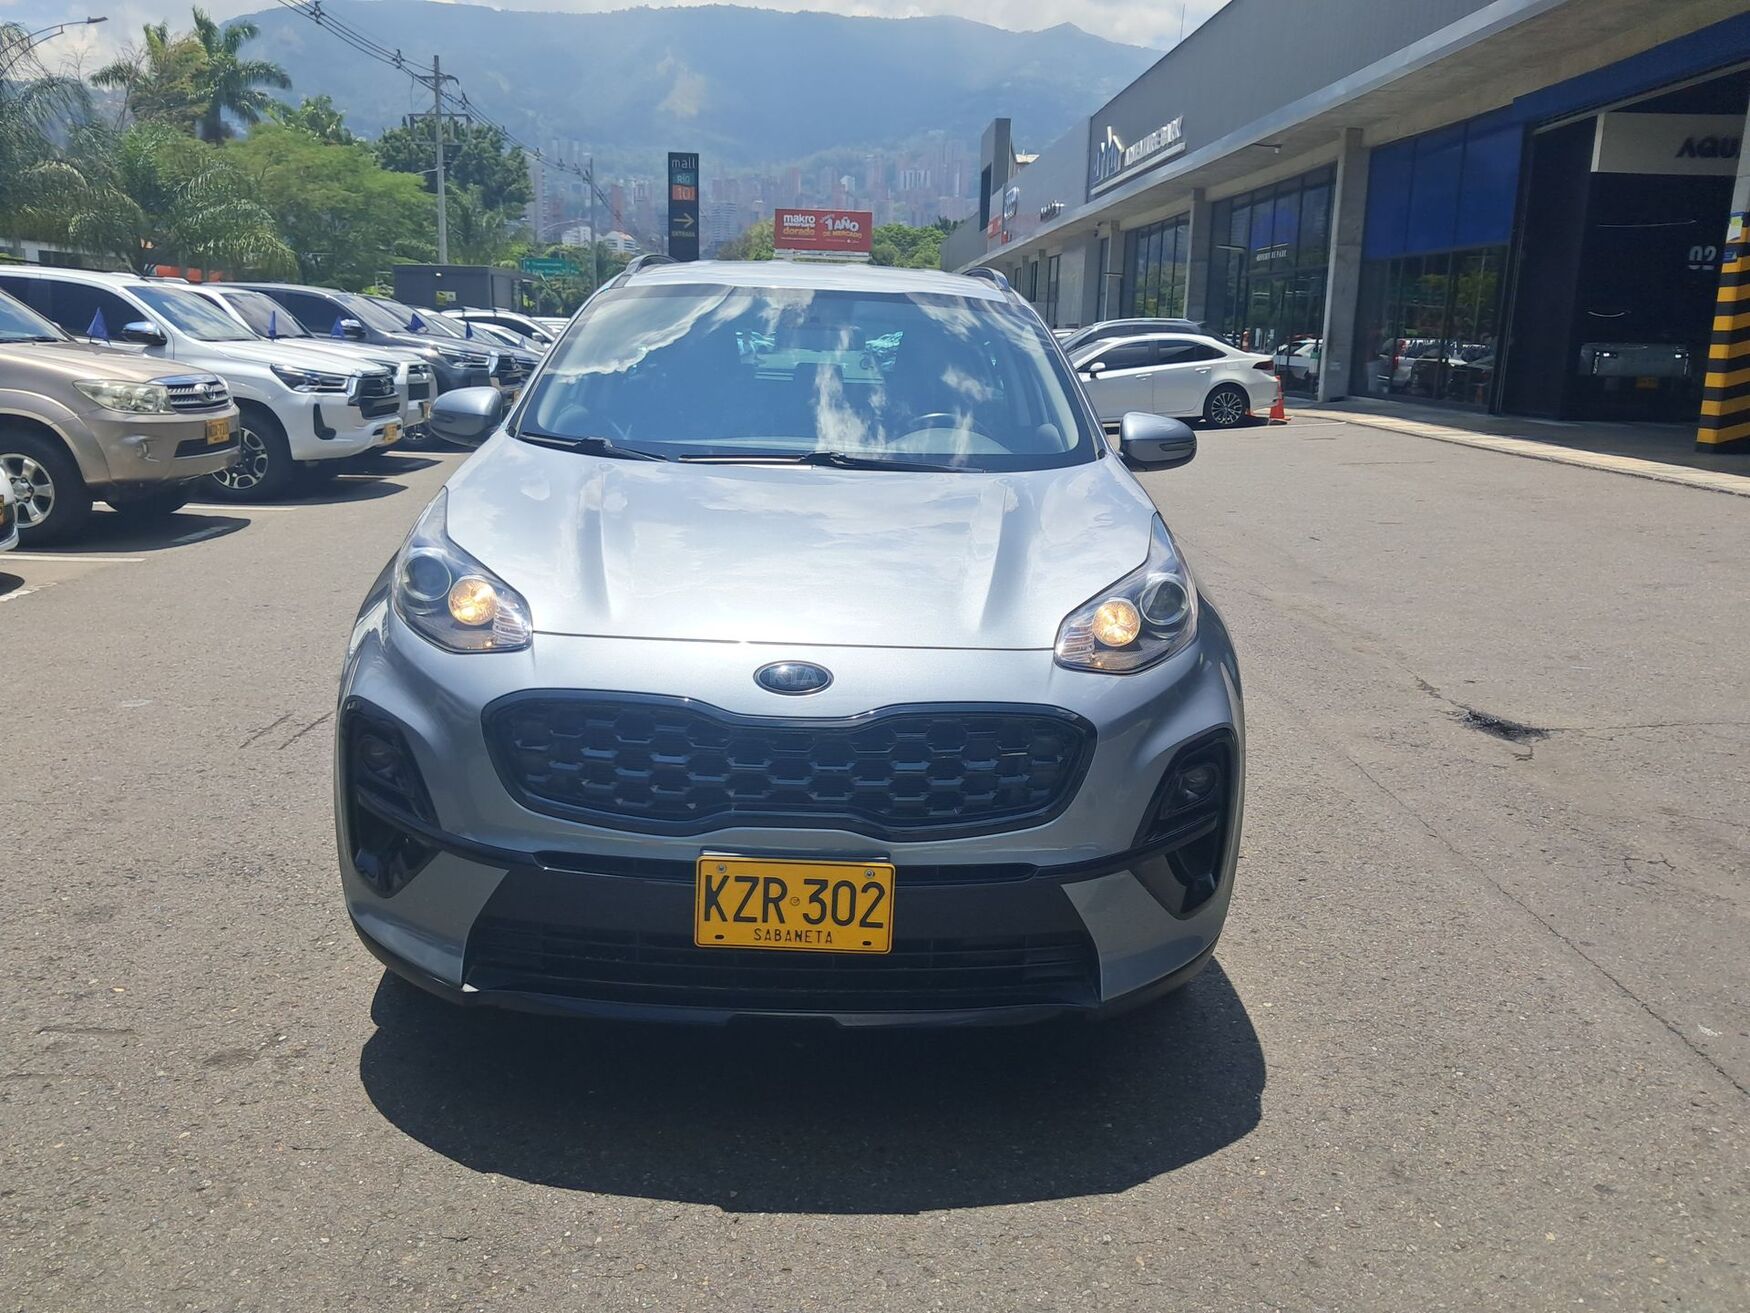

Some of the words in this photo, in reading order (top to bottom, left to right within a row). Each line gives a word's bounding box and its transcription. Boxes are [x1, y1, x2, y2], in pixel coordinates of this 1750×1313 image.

[672, 157, 696, 168] mall
[784, 214, 815, 223] makro
[825, 219, 834, 230] 1
[834, 217, 859, 231] AÑO
[783, 227, 815, 235] dorado
[1688, 245, 1717, 271] 02
[767, 667, 820, 686] KIA
[704, 874, 788, 924] KZR
[802, 878, 886, 929] 302
[754, 928, 833, 944] SABANETA
